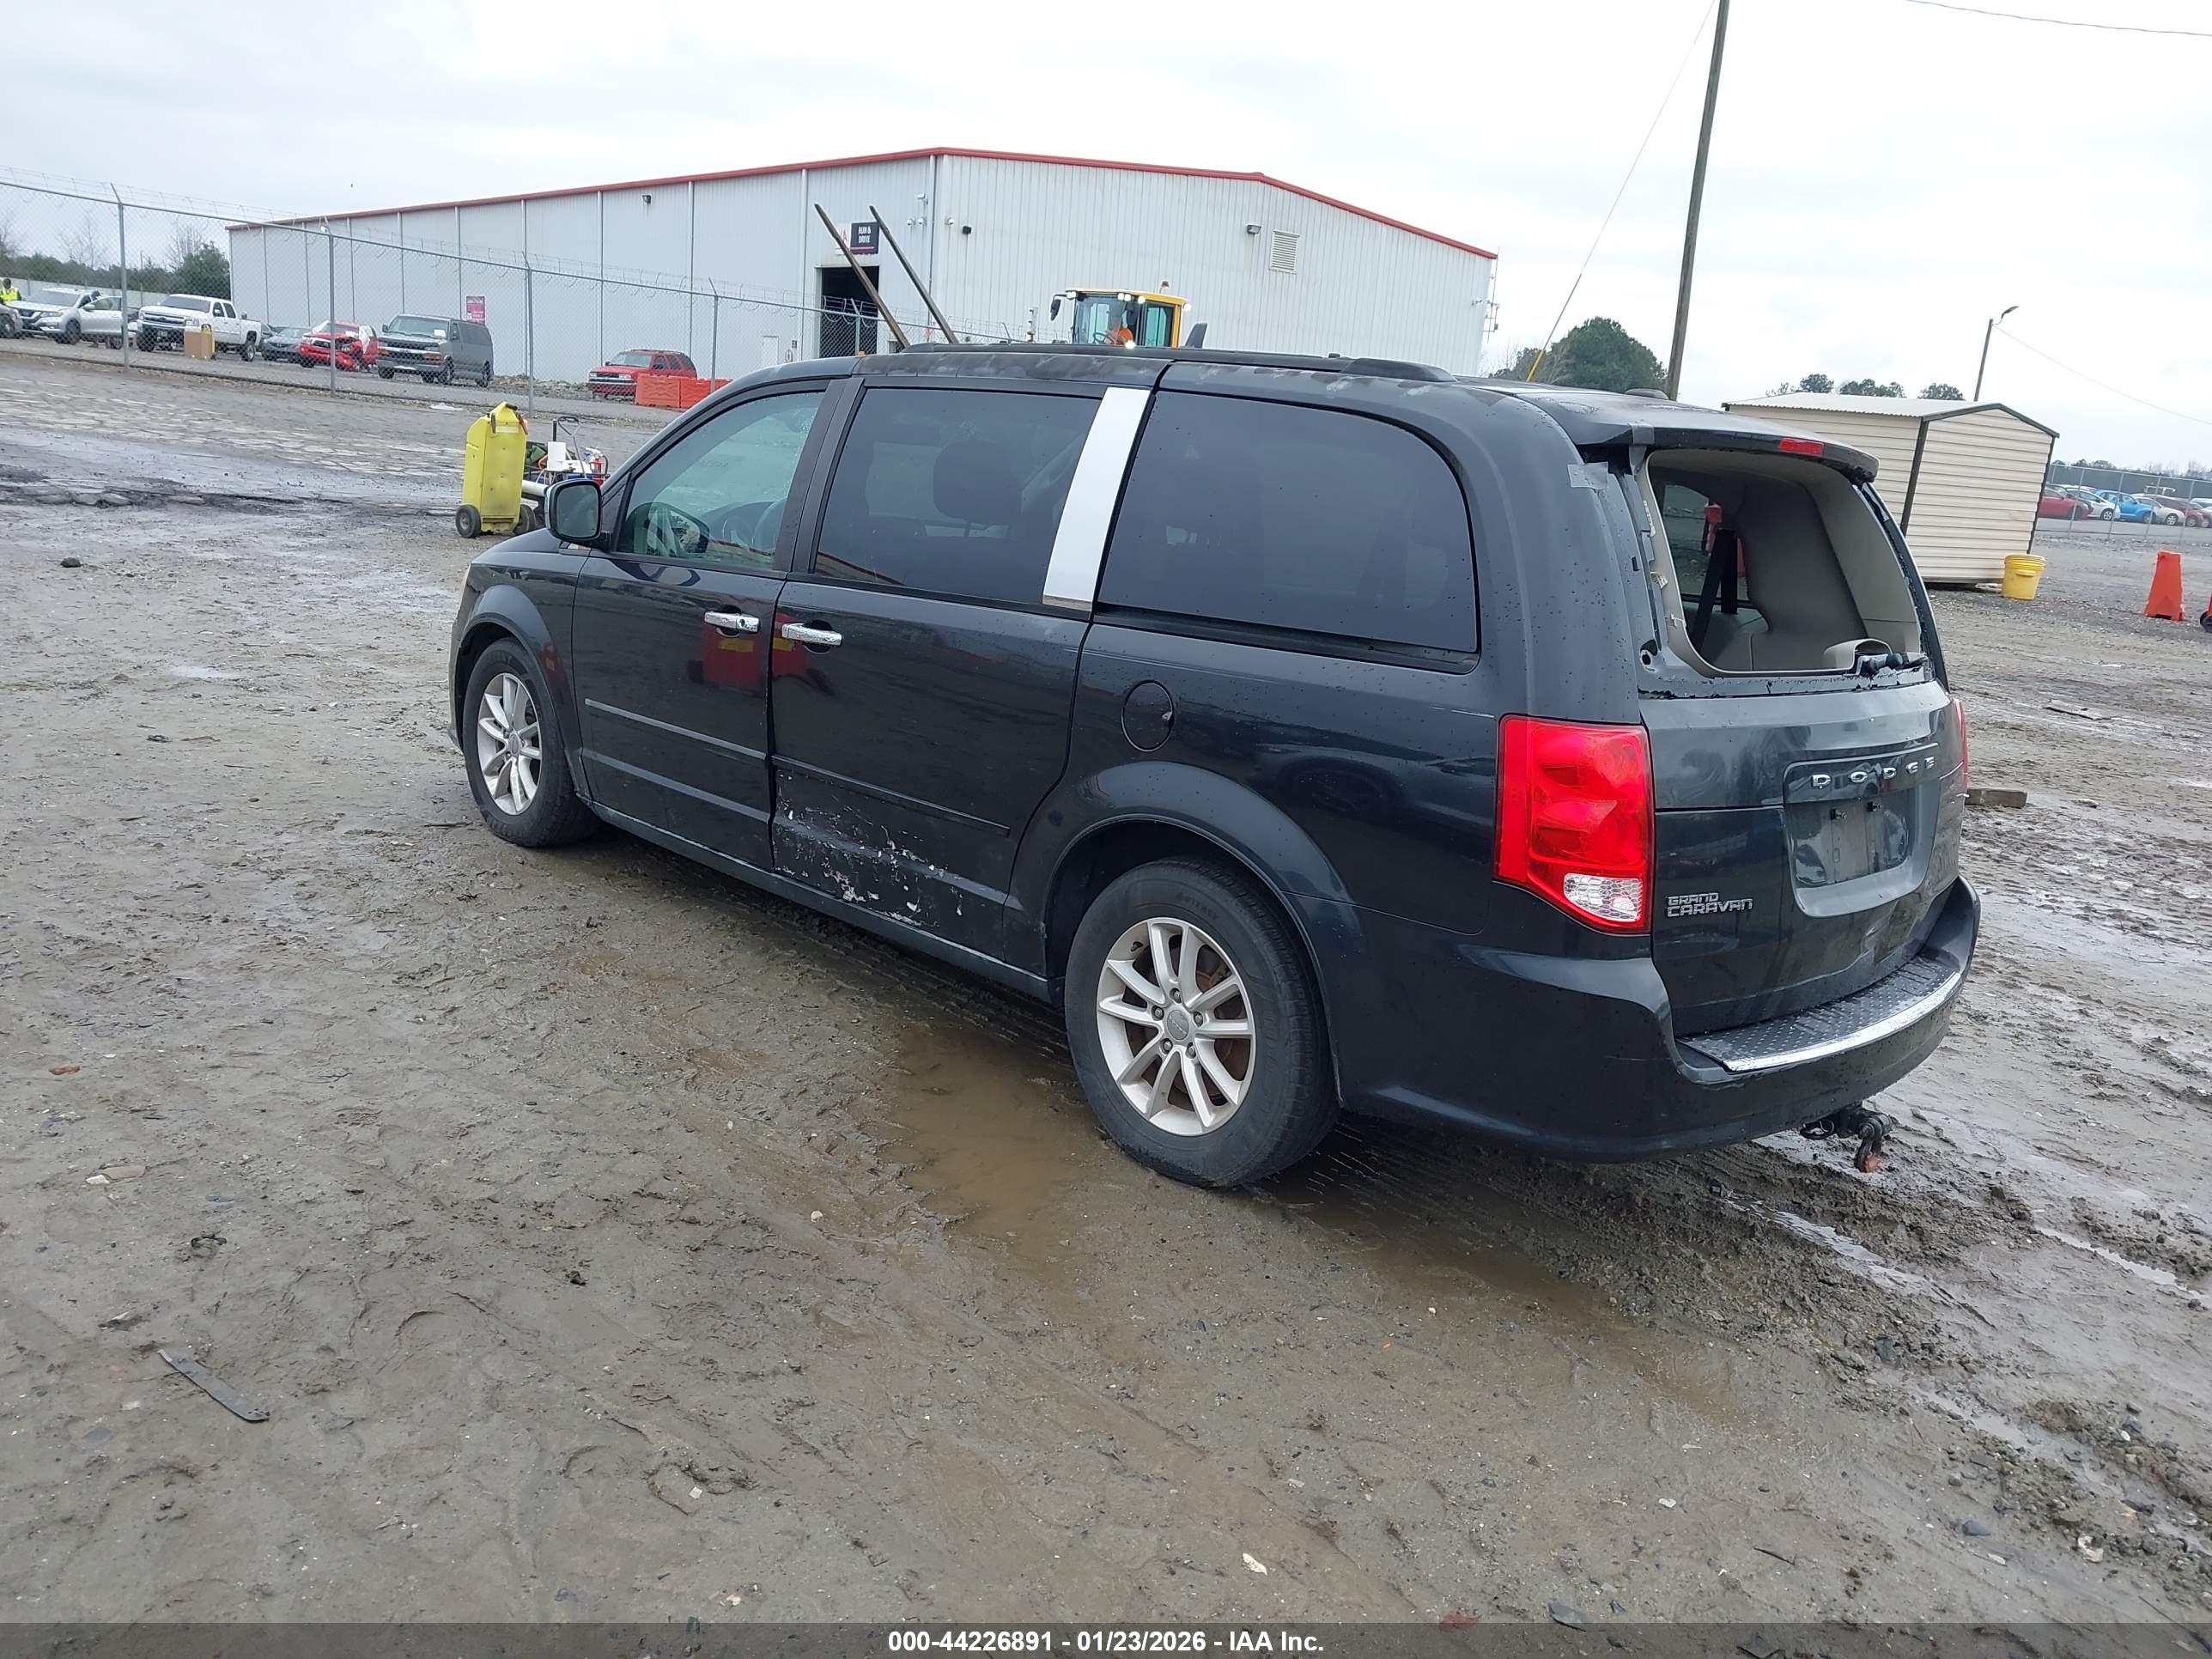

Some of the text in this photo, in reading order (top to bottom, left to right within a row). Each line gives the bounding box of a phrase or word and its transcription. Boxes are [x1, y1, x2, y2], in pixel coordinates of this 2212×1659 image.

[1811, 757, 1936, 787] DODGE
[1667, 892, 1719, 906] GRAND
[1667, 898, 1753, 918] CARAVAN
